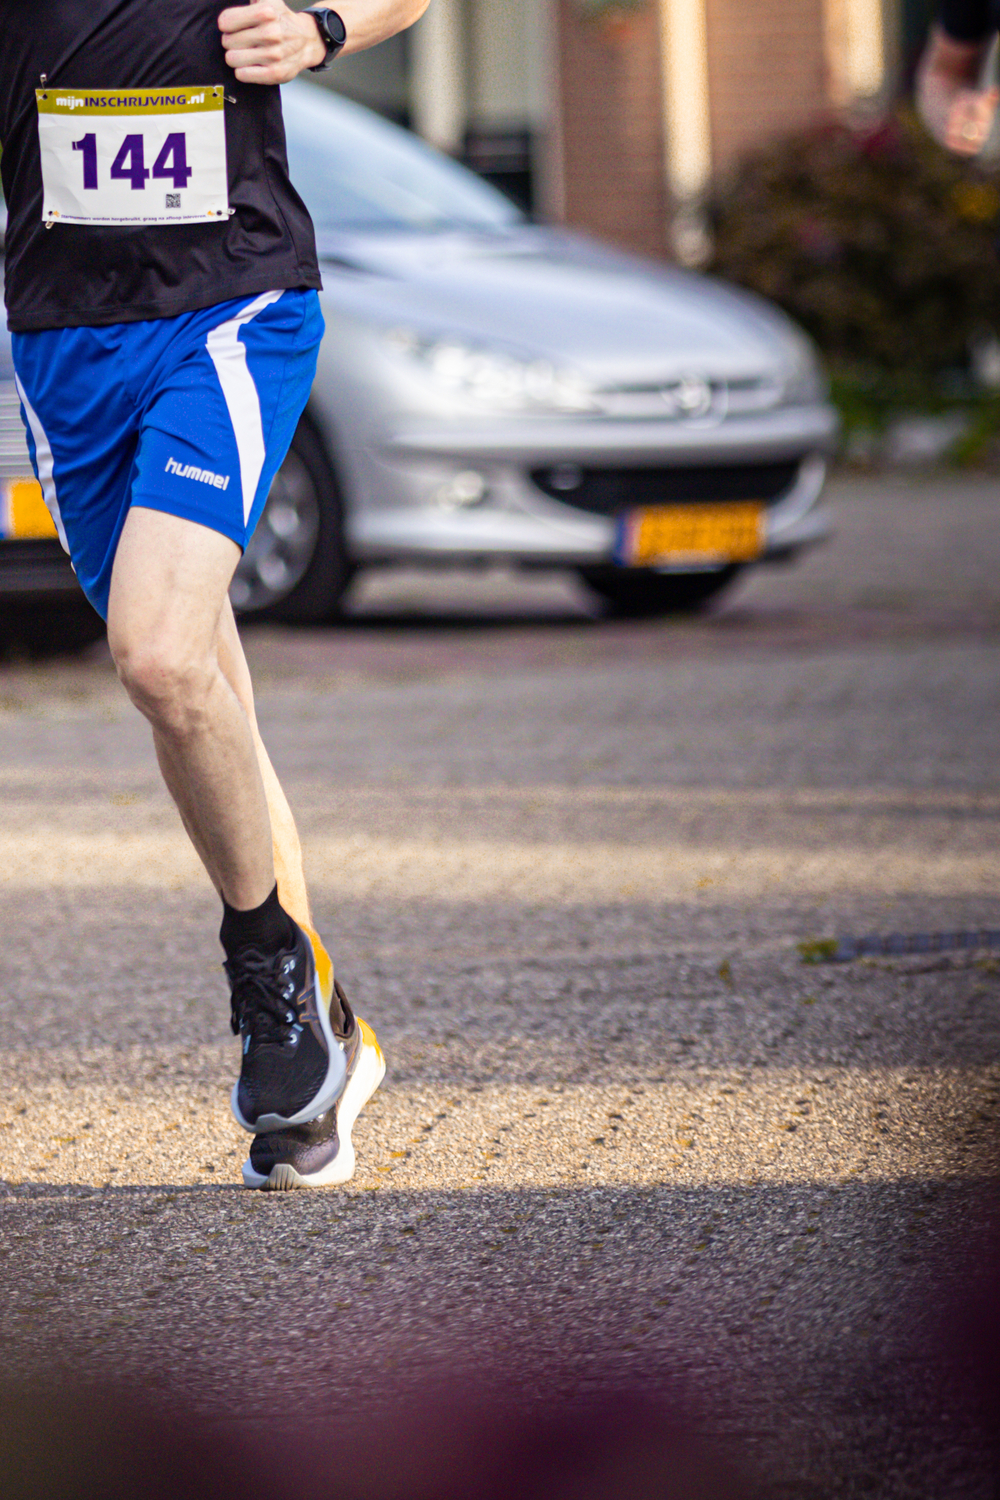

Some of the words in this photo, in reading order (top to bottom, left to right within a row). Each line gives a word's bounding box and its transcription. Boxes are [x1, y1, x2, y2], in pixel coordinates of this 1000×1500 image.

[55, 92, 205, 110] mijnINSCHRIJVING.nl
[71, 132, 193, 191] 144
[164, 456, 230, 491] hummel
